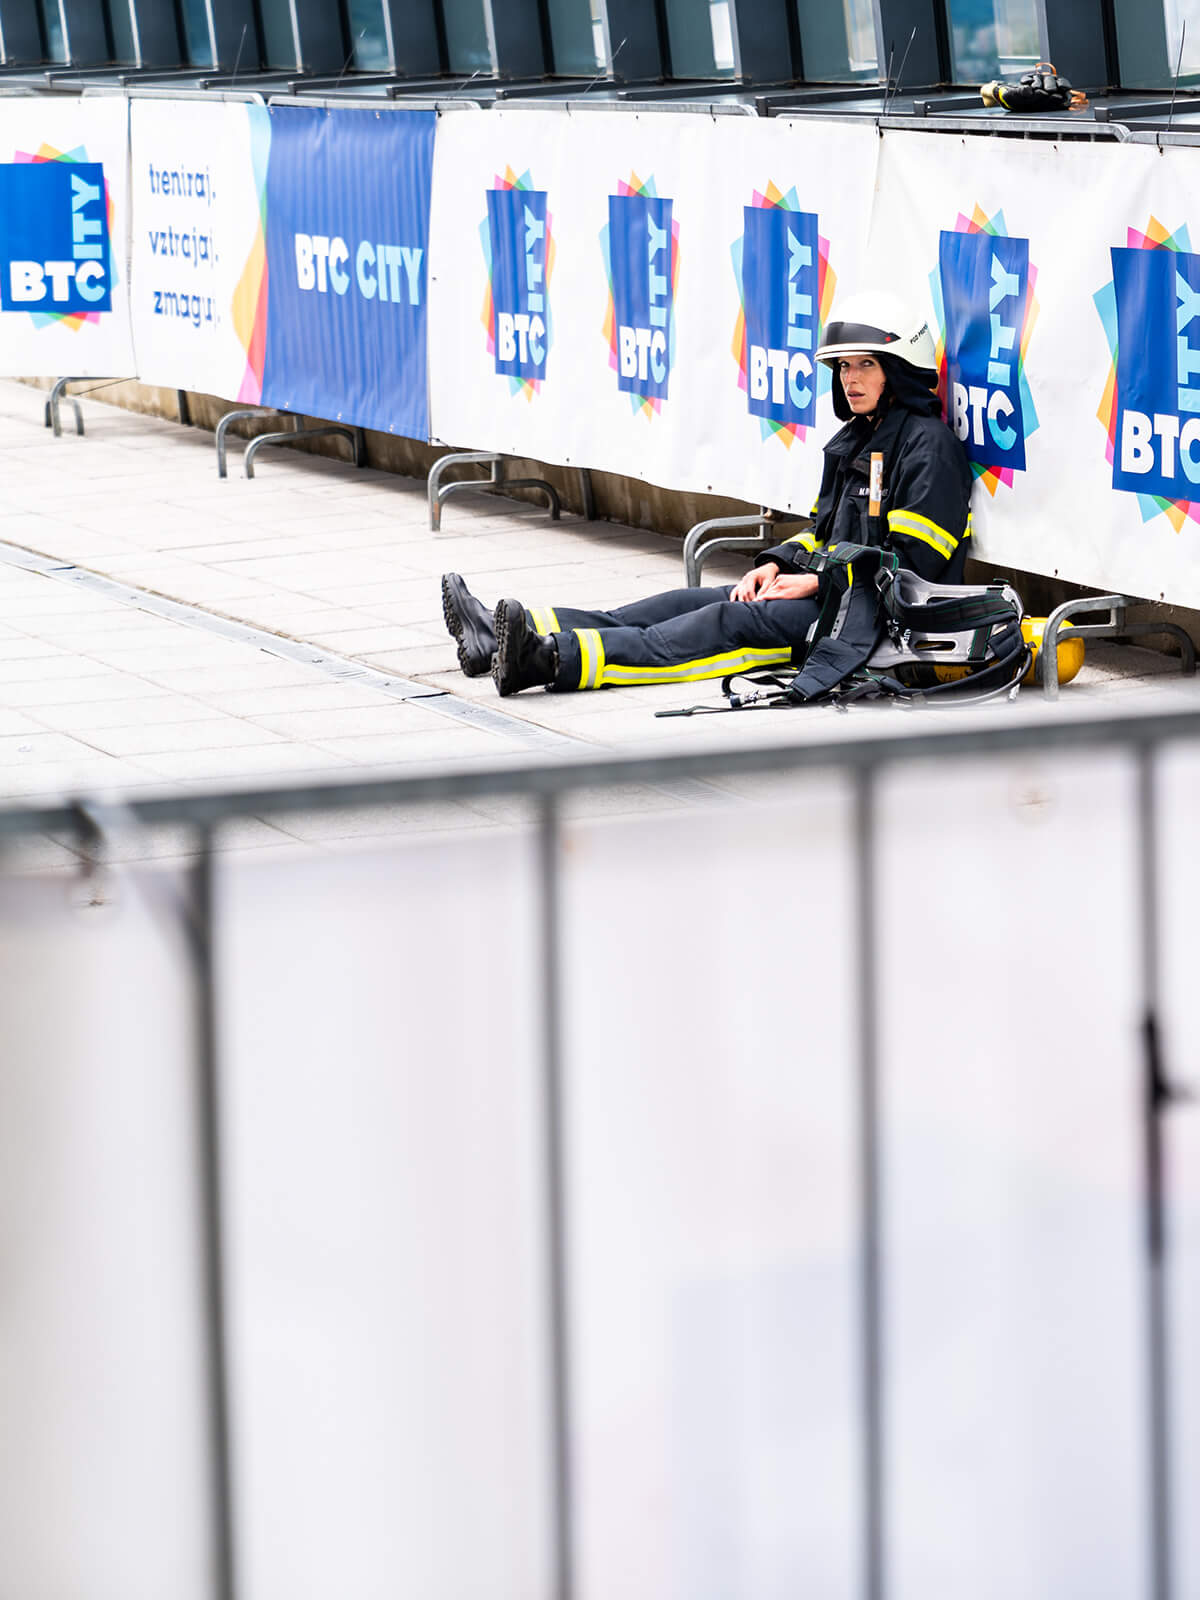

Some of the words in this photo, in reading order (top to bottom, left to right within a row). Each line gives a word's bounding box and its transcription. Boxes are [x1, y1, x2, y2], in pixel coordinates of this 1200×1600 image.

[149, 163, 216, 207] treniraj.
[148, 225, 219, 269] vztrajaj.
[295, 233, 350, 295] BTC
[356, 240, 423, 306] CITY
[9, 260, 106, 302] BTC
[498, 312, 545, 366] BTC
[619, 326, 666, 384] BTC
[750, 345, 813, 410] BTC
[953, 382, 1017, 451] BTC
